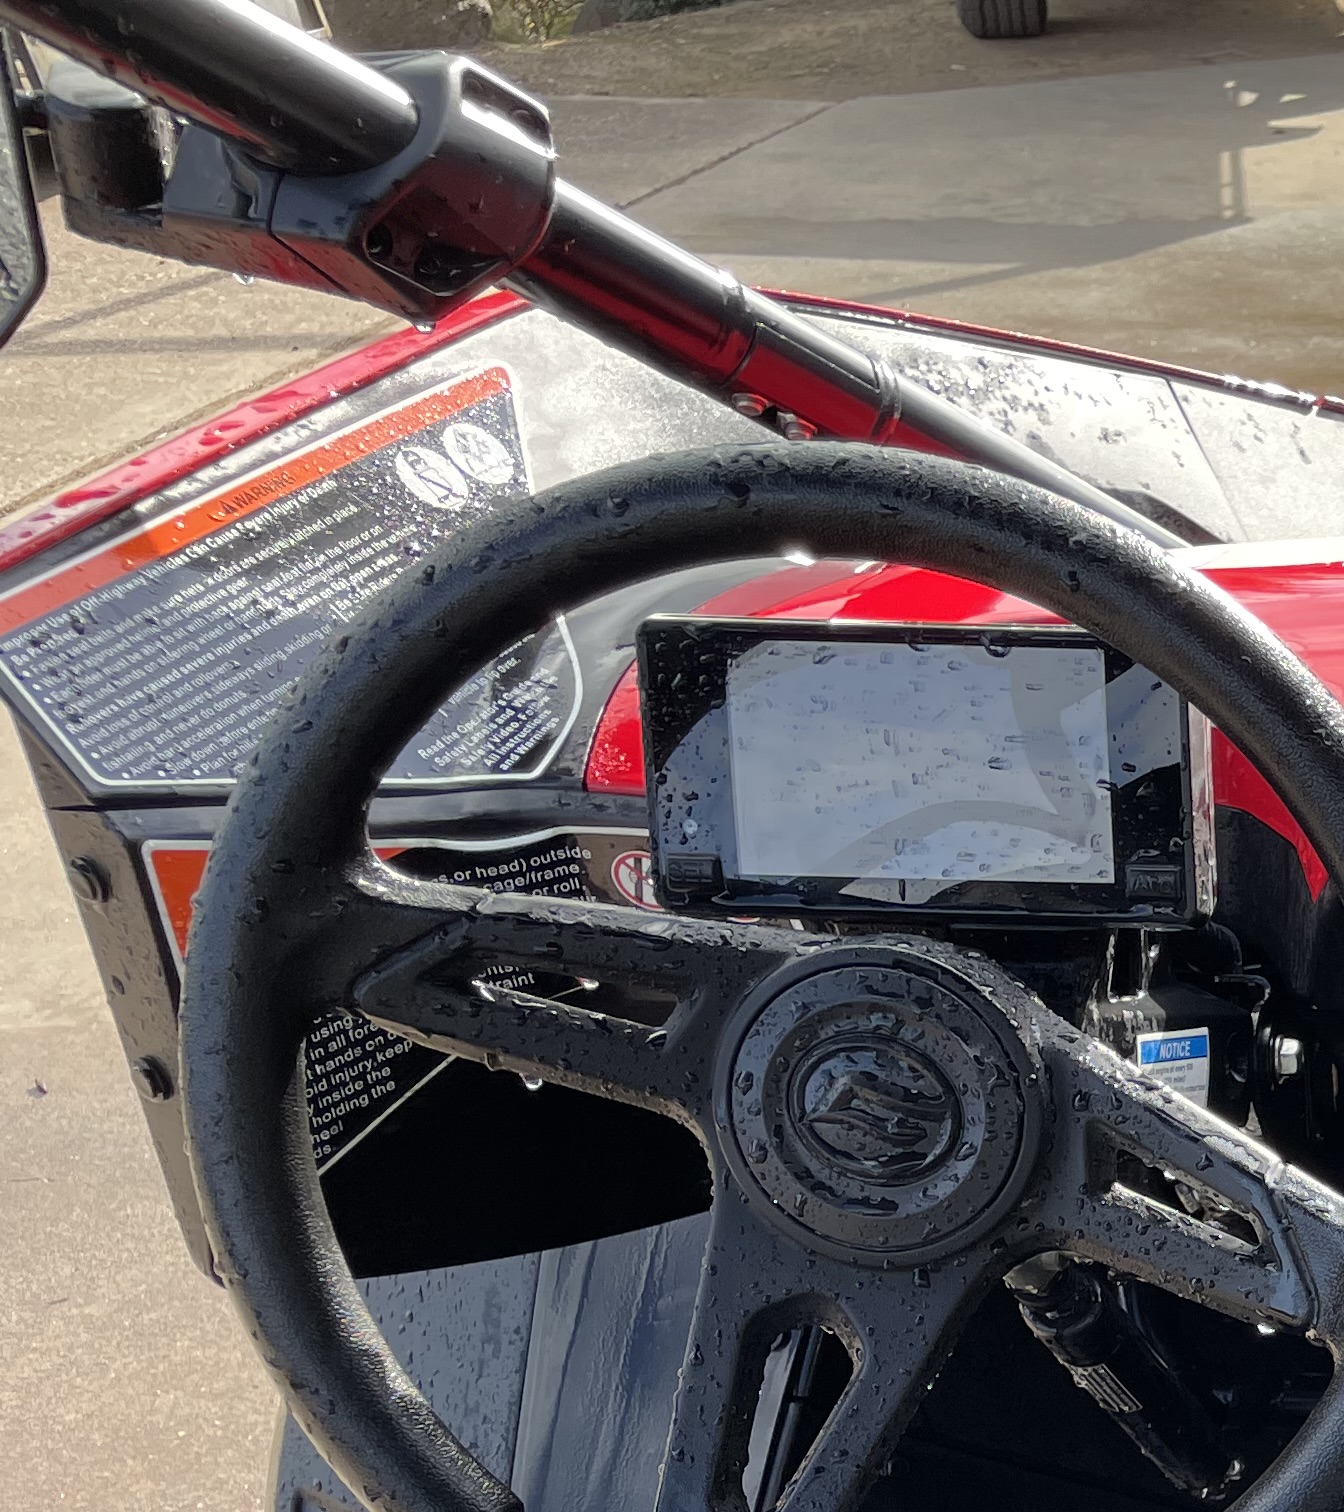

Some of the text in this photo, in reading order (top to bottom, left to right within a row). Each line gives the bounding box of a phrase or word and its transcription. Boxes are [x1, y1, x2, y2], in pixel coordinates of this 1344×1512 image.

[235, 472, 296, 514] WARNING
[475, 846, 591, 879] head) outside
[533, 887, 549, 896] or
[311, 1016, 353, 1043] using
[309, 1034, 346, 1060] in all
[315, 1035, 384, 1075] hands on
[1160, 1041, 1190, 1058] NOTICE
[312, 1081, 395, 1127] holding the
[318, 1067, 391, 1108] inside the
